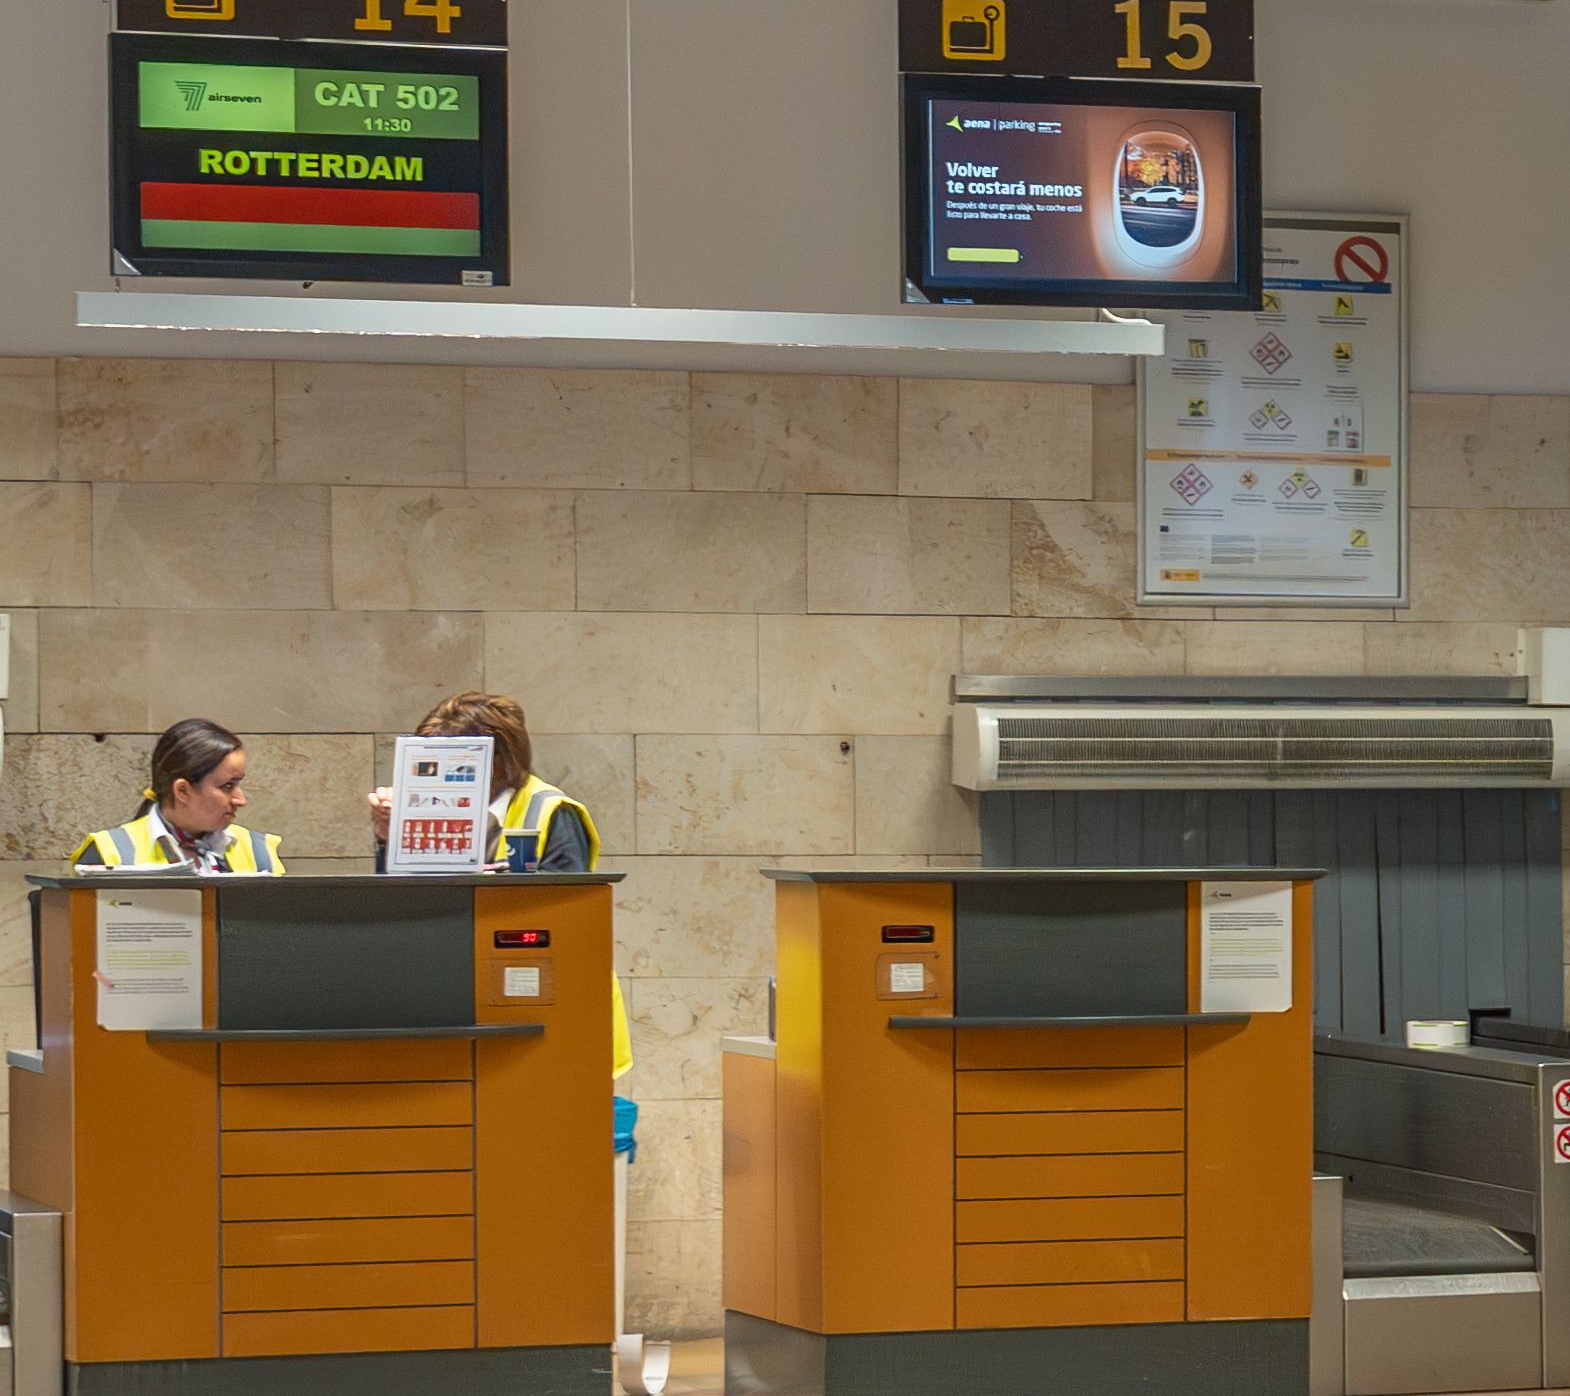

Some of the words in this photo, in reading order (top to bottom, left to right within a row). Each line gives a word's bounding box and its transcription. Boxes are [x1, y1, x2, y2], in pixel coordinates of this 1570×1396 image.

[207, 92, 262, 103] airseven
[314, 81, 386, 108] CAT
[396, 84, 460, 111] 502
[363, 117, 412, 132] 11:30
[998, 119, 1036, 132] parking
[199, 148, 424, 182] ROTTERDAM
[946, 162, 999, 178] Volver
[946, 180, 965, 194] te
[968, 181, 1026, 196] costará
[1029, 184, 1083, 198] menos
